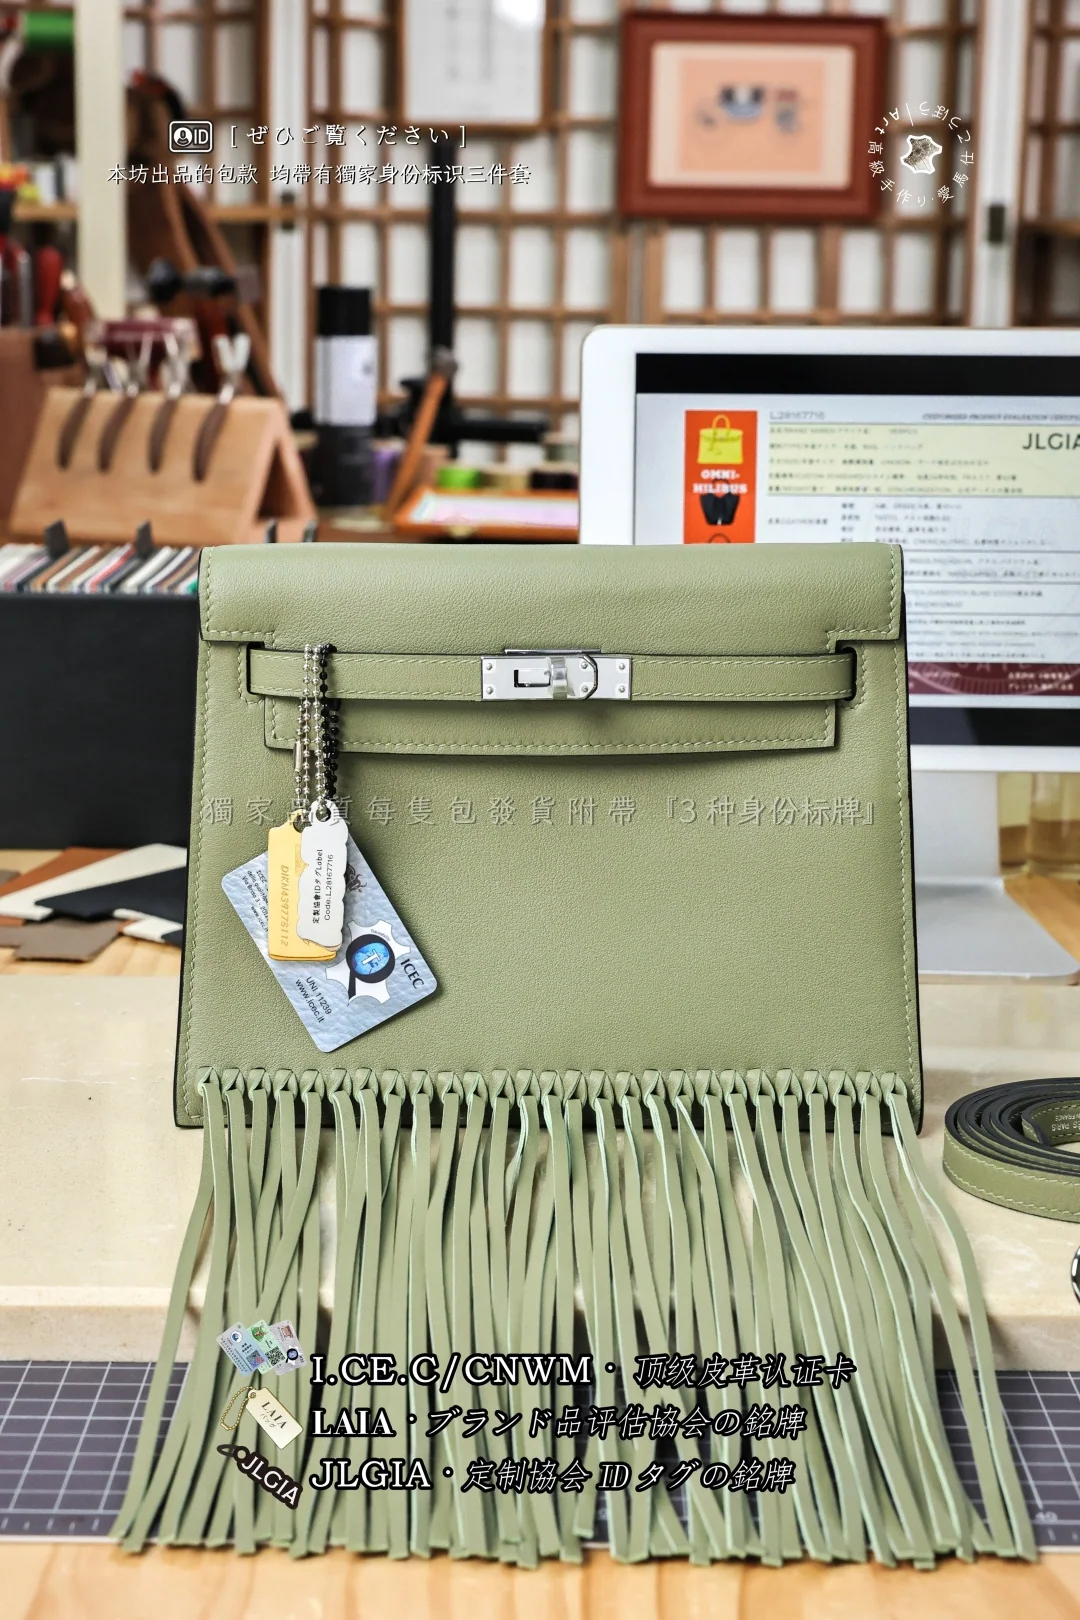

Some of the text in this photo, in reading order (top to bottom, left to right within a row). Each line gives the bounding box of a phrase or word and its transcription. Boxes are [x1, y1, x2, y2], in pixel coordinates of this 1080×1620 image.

[400, 958, 425, 989] ICEC
[295, 979, 326, 1024] www.icec.it
[305, 976, 332, 1015] UNI 11239
